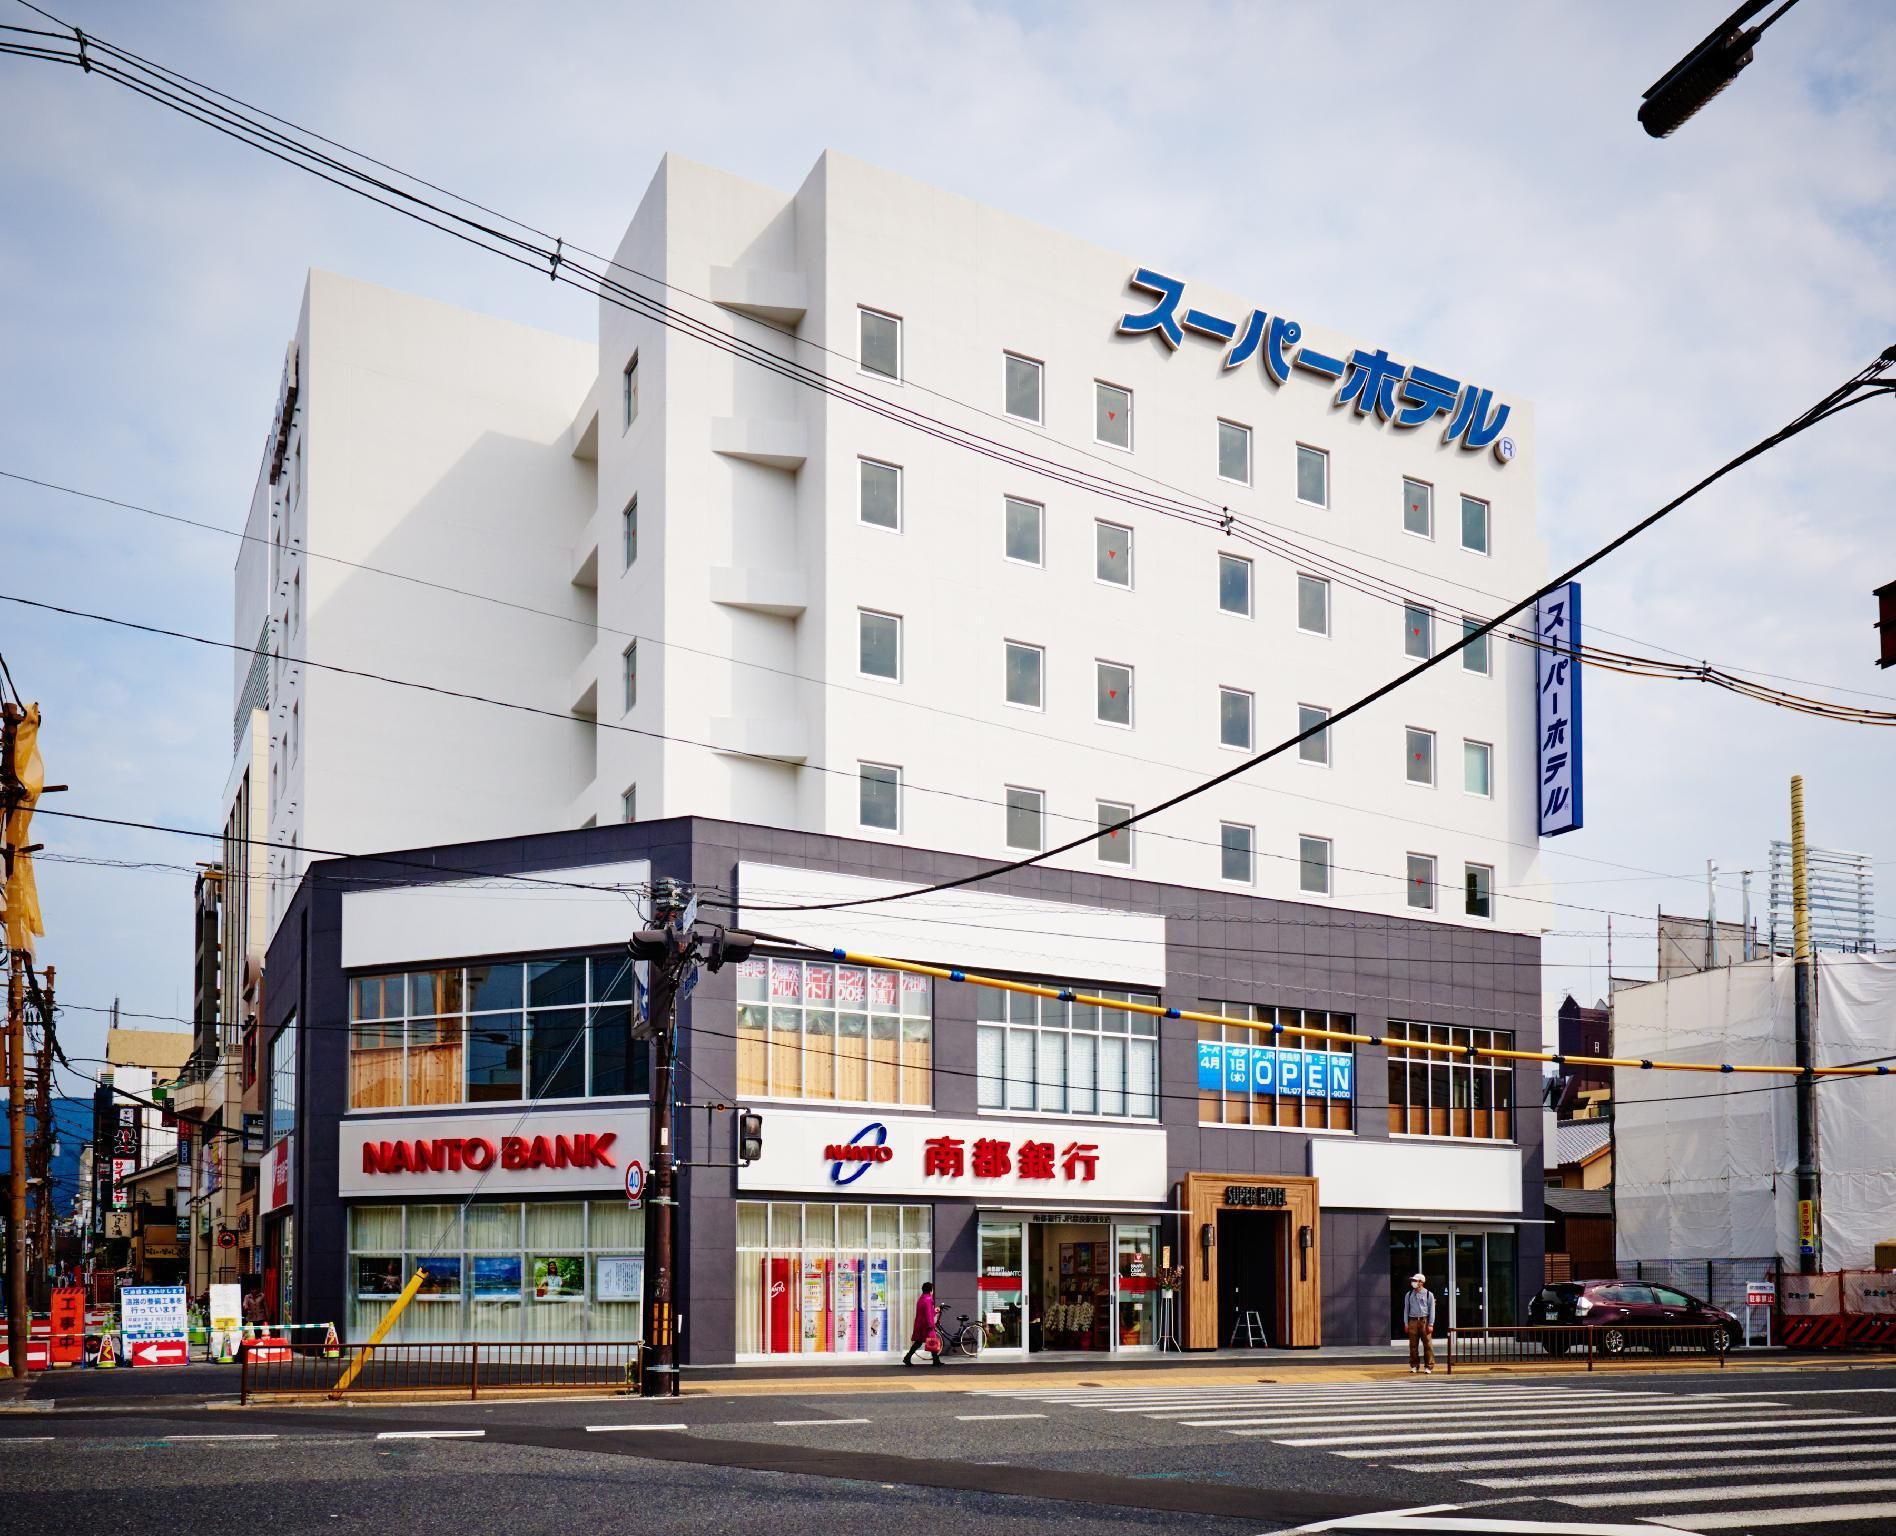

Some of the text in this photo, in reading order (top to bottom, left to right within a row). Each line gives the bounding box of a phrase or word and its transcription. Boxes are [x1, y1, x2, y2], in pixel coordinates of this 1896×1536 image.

[1117, 266, 1511, 449] スーパーホテル
[1543, 601, 1570, 818] スーパーホテル
[1255, 1061, 1349, 1090] OPEN
[362, 1133, 617, 1174] NANTO BANK
[824, 1144, 893, 1163] NANTO
[925, 1136, 1099, 1181] 南都銀行
[629, 1171, 639, 1188] 40
[1226, 1186, 1287, 1206] SUPER HOTEL
[178, 1218, 190, 1229] 本
[131, 1306, 177, 1314] 行っています
